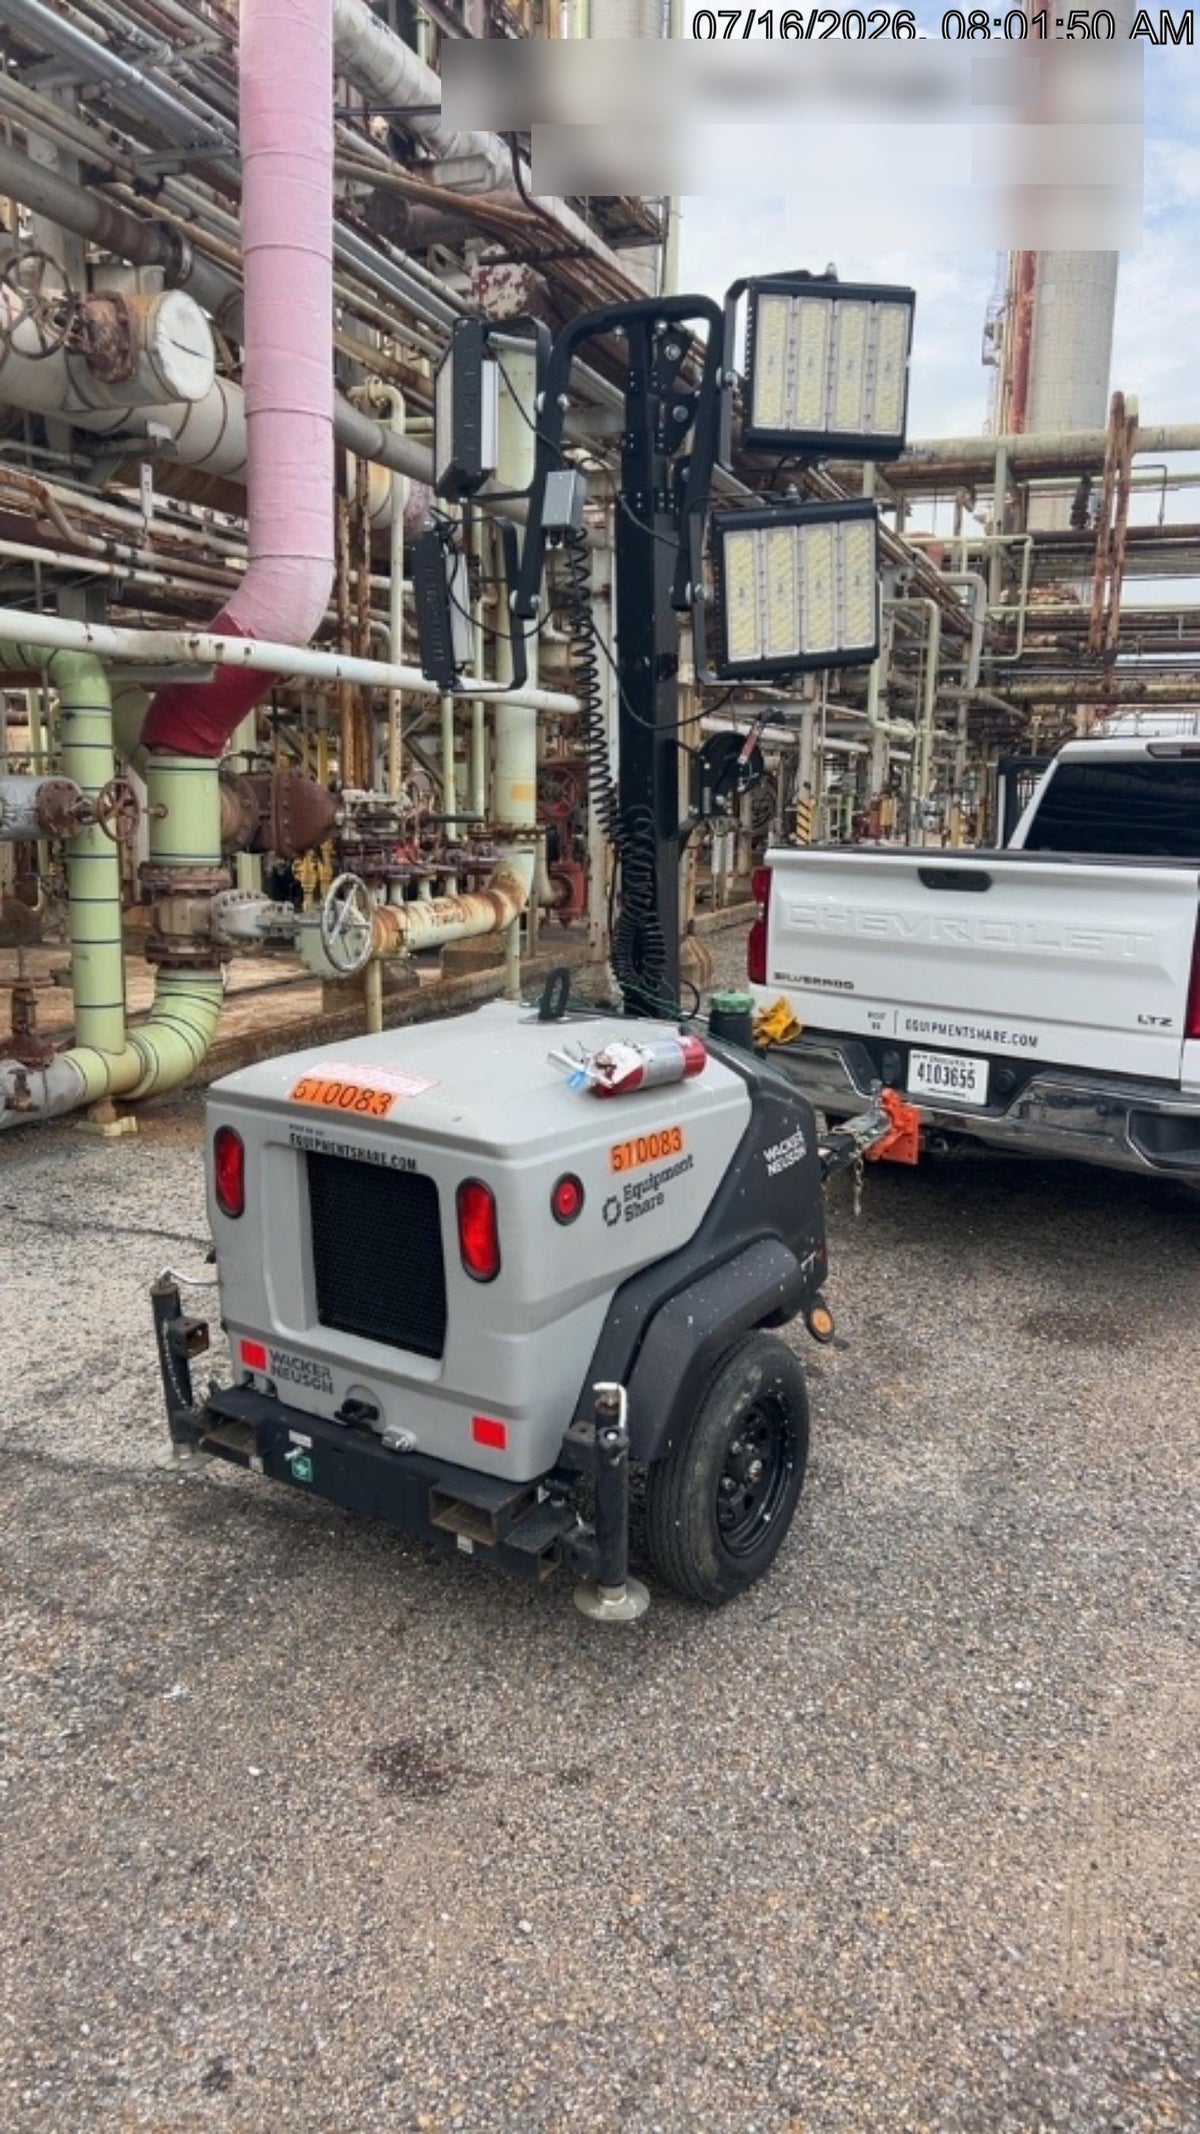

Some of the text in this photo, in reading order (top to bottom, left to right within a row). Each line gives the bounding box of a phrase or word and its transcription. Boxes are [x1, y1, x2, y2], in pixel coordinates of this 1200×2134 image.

[785, 904, 1155, 957] CHEVROLET
[773, 971, 855, 990] SILVERADO
[905, 1018, 1038, 1048] EQUIPMENTSHARE.COM
[1137, 1014, 1172, 1027] LTZ
[623, 1154, 694, 1203] Equipment
[624, 1191, 665, 1223] Share
